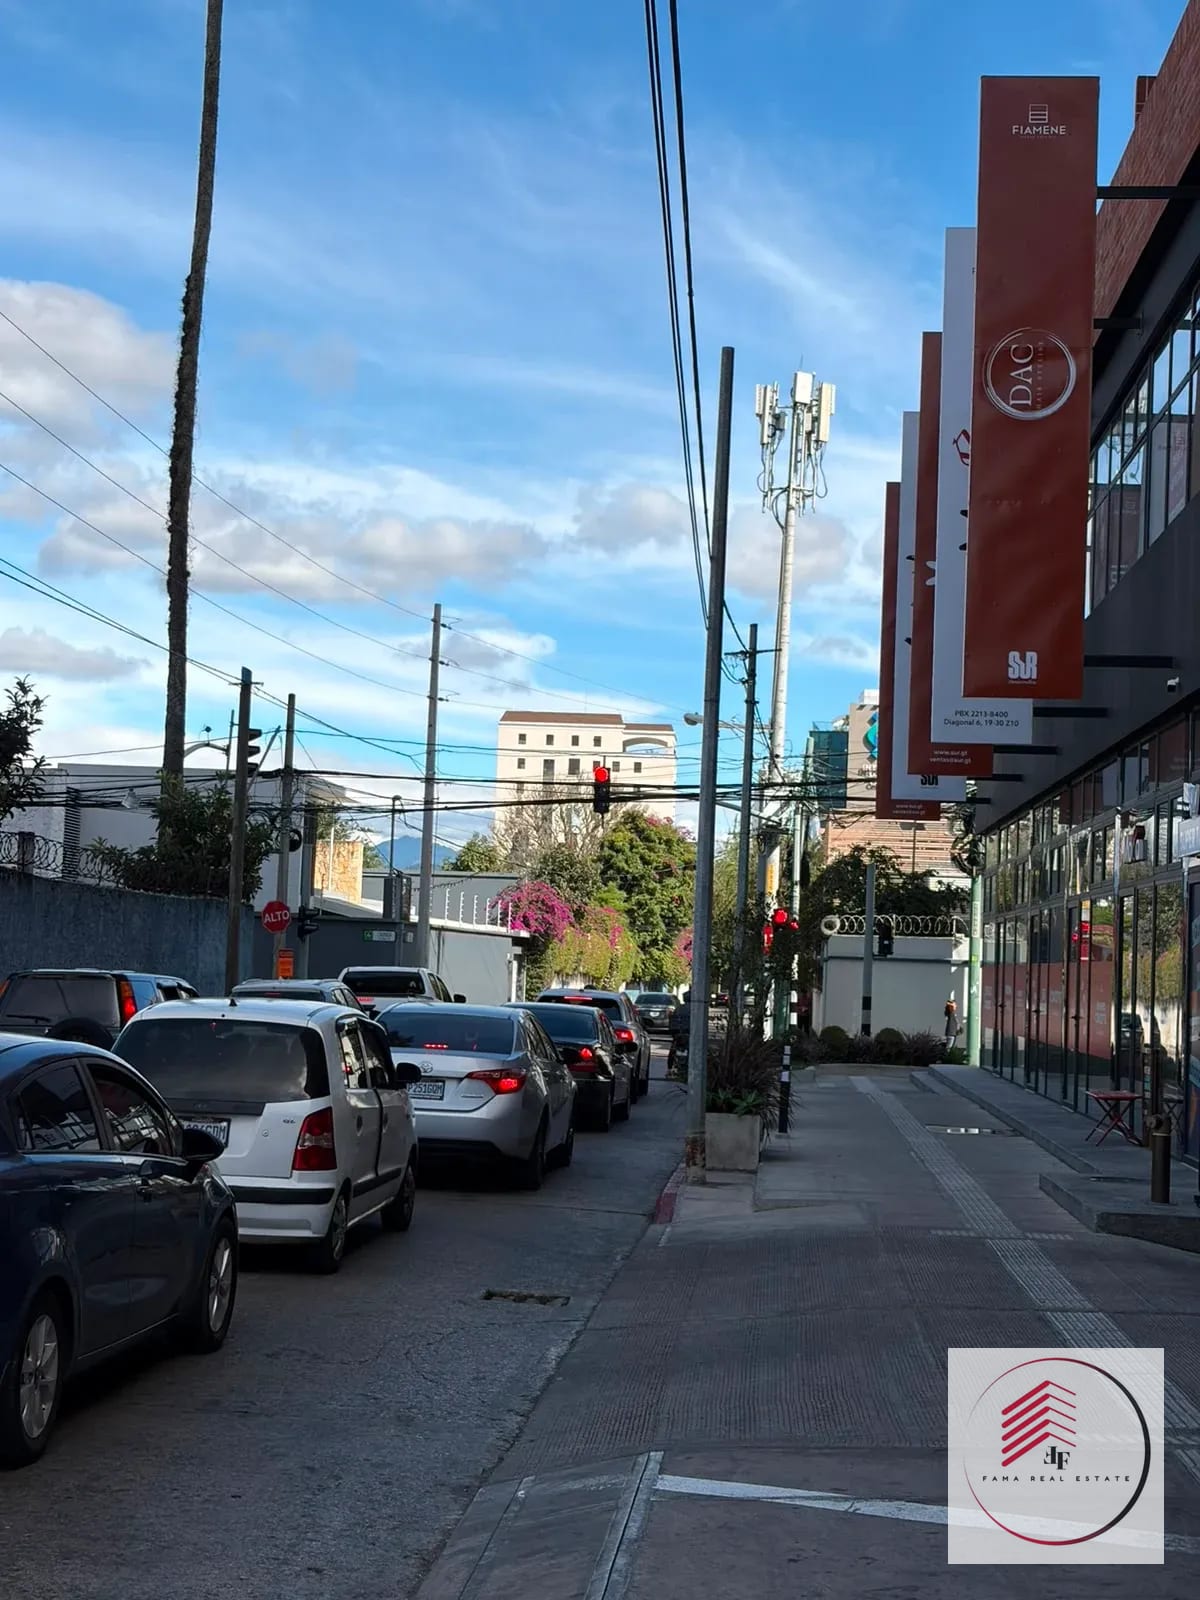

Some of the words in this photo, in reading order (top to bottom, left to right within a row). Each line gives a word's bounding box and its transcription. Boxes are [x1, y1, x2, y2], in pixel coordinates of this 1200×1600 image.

[1012, 125, 1067, 135] FIAMENE
[1010, 344, 1034, 406] DAC
[1008, 651, 1037, 680] SUR
[944, 719, 973, 727] Diagonal
[264, 910, 290, 924] ALTO
